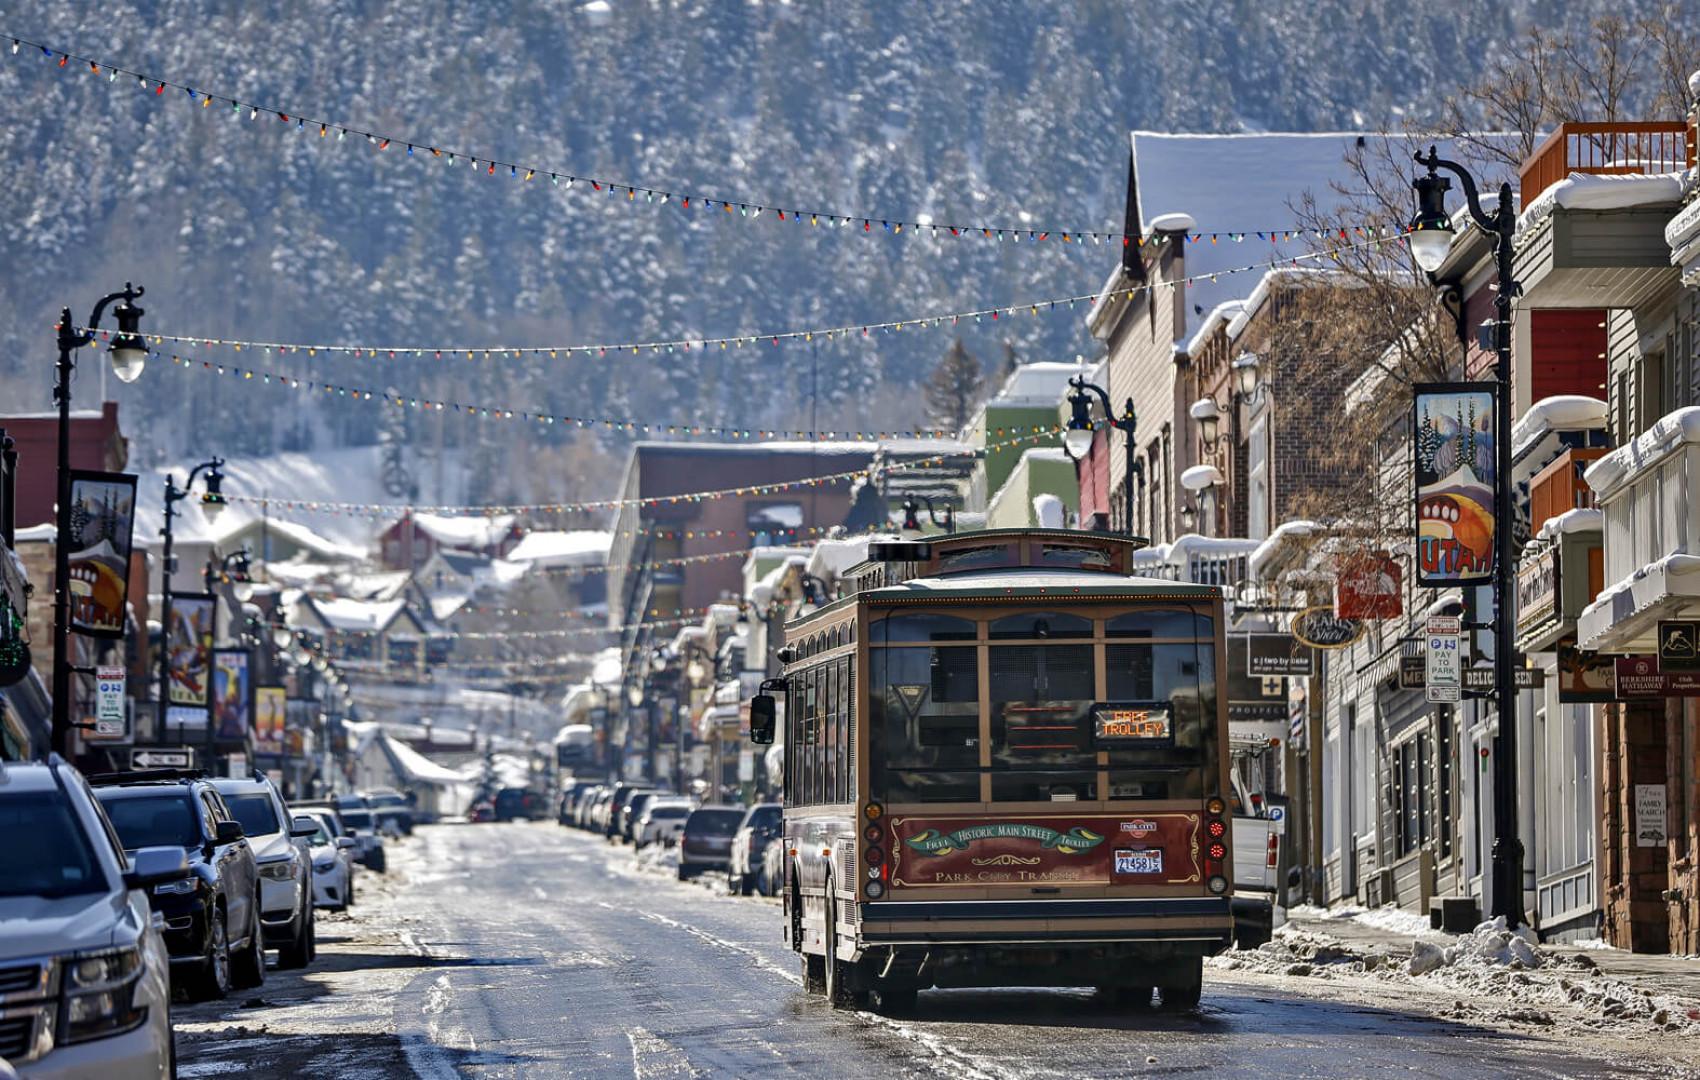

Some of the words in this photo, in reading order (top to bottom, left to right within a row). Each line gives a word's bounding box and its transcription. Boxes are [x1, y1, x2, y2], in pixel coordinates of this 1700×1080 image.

[1421, 539, 1493, 572] UTAH
[1434, 651, 1452, 659] PAY
[1228, 706, 1286, 714] PROSPECT
[1114, 711, 1148, 722] FREE
[1103, 723, 1163, 736] TROLLEY
[1639, 799, 1662, 808] FAMILY
[1637, 808, 1665, 816] SEARCH
[936, 871, 970, 881] PARK
